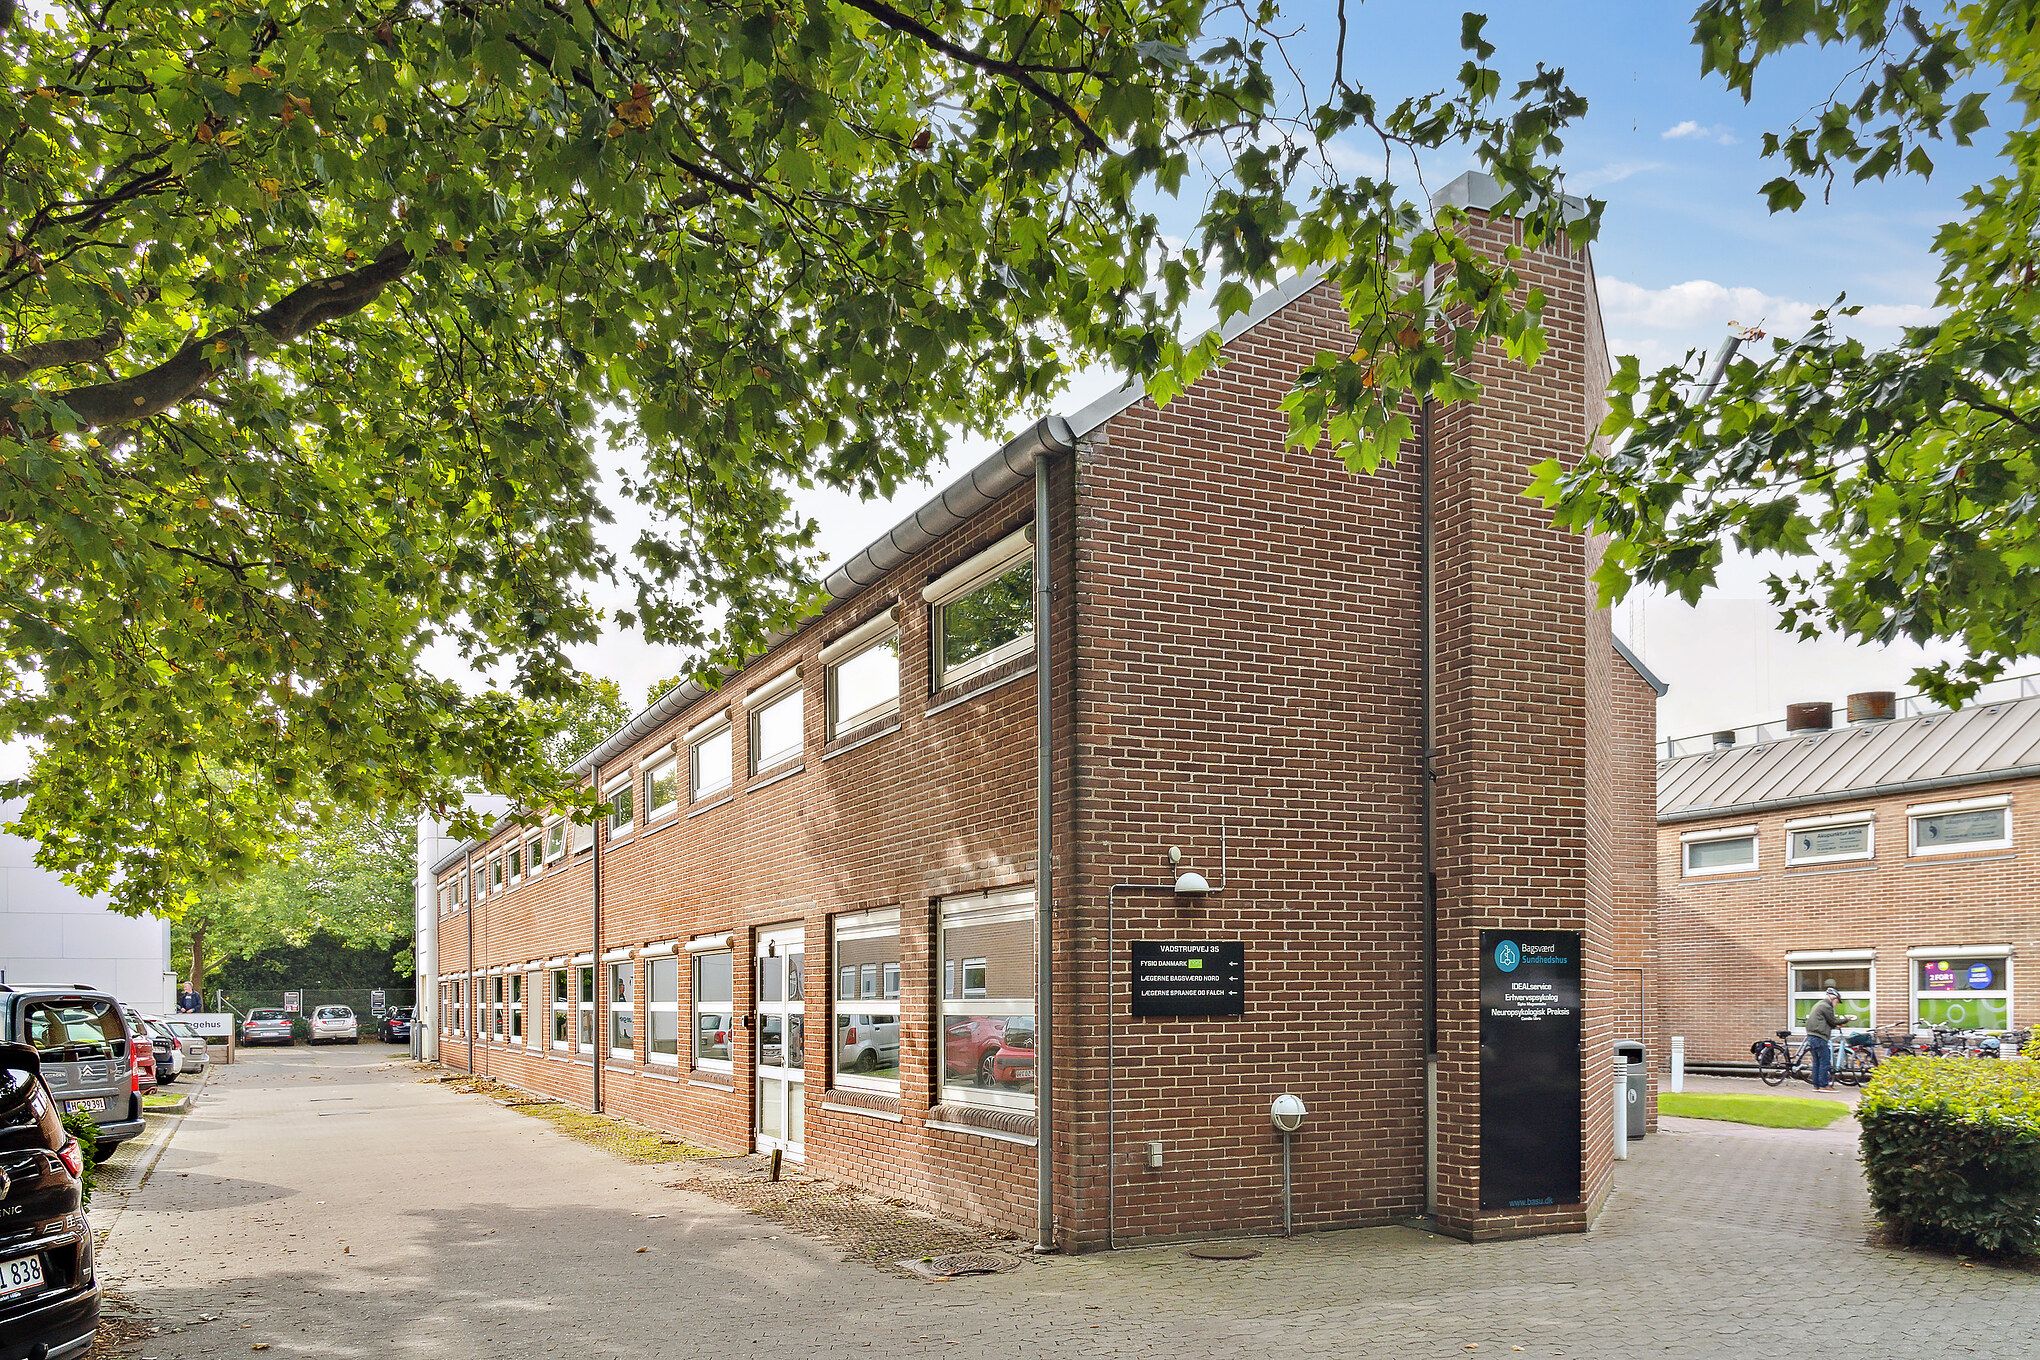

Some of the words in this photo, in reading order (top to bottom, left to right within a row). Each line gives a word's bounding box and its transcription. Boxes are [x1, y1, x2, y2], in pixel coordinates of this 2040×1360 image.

[1160, 945, 1209, 953] VADSTRUPVEJ
[1521, 944, 1555, 954] Bagsværd
[1521, 955, 1568, 964] Sundhedshus
[1505, 994, 1559, 1002] Erhvervspsykolog
[1491, 1008, 1546, 1018] Neuropsykologisk
[1546, 1007, 1570, 1016] Praksis
[91, 1099, 104, 1109] 391
[11, 1258, 40, 1285] 838
